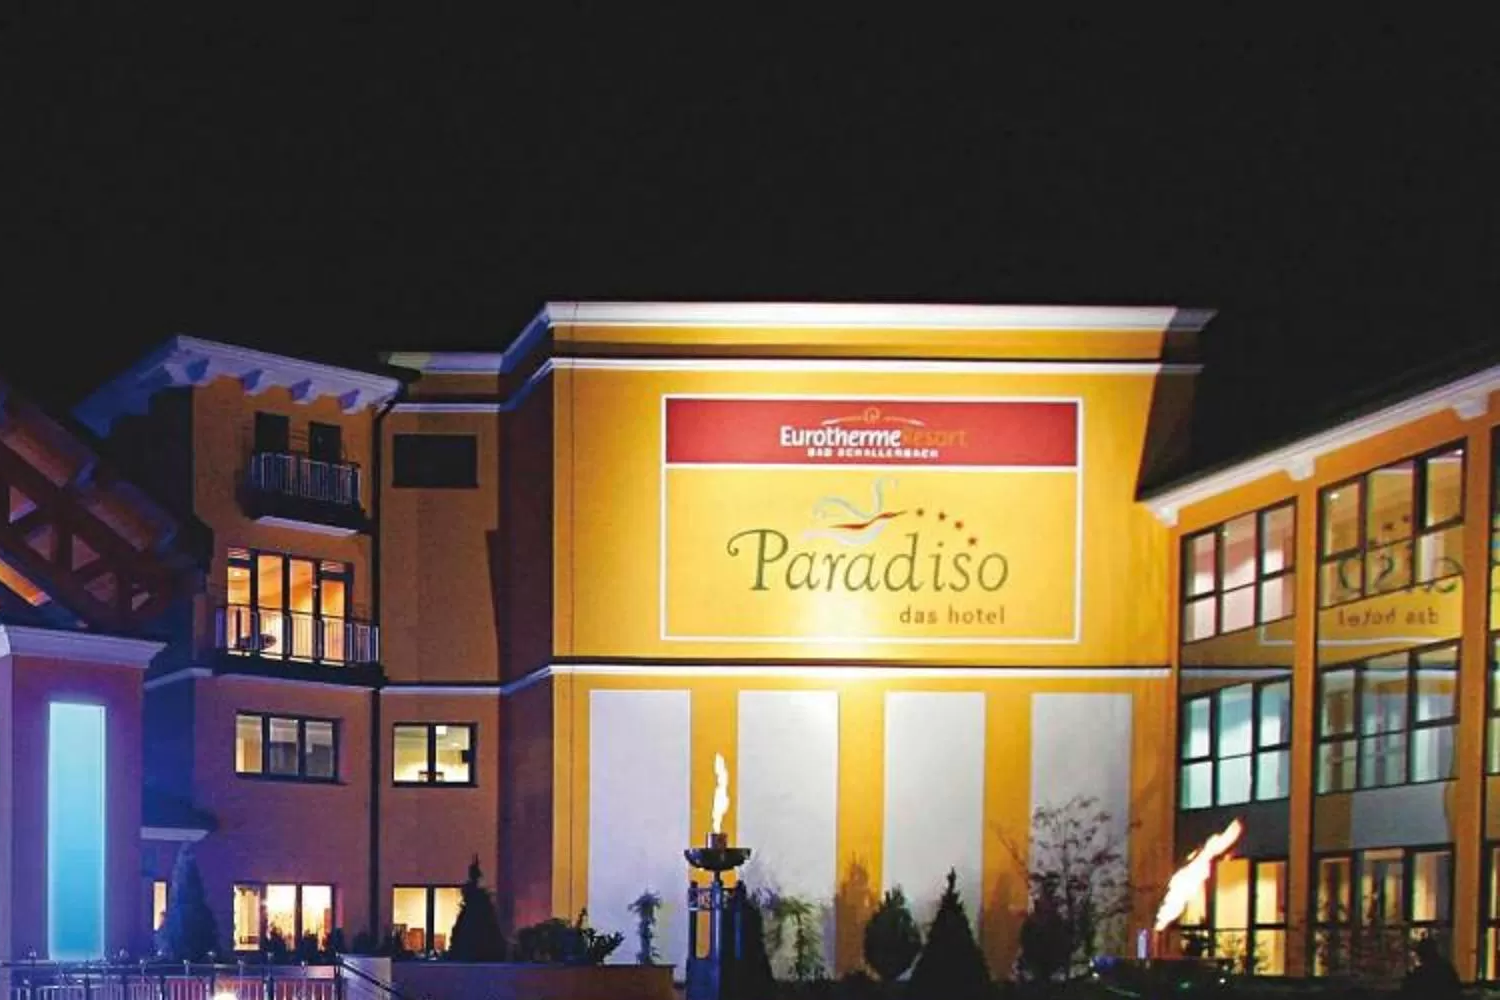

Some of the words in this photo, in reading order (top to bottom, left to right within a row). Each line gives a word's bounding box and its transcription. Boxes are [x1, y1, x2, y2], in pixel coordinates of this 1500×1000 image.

[726, 528, 1009, 593] Paradiso
[899, 605, 938, 626] das
[948, 605, 1006, 625] hotel
